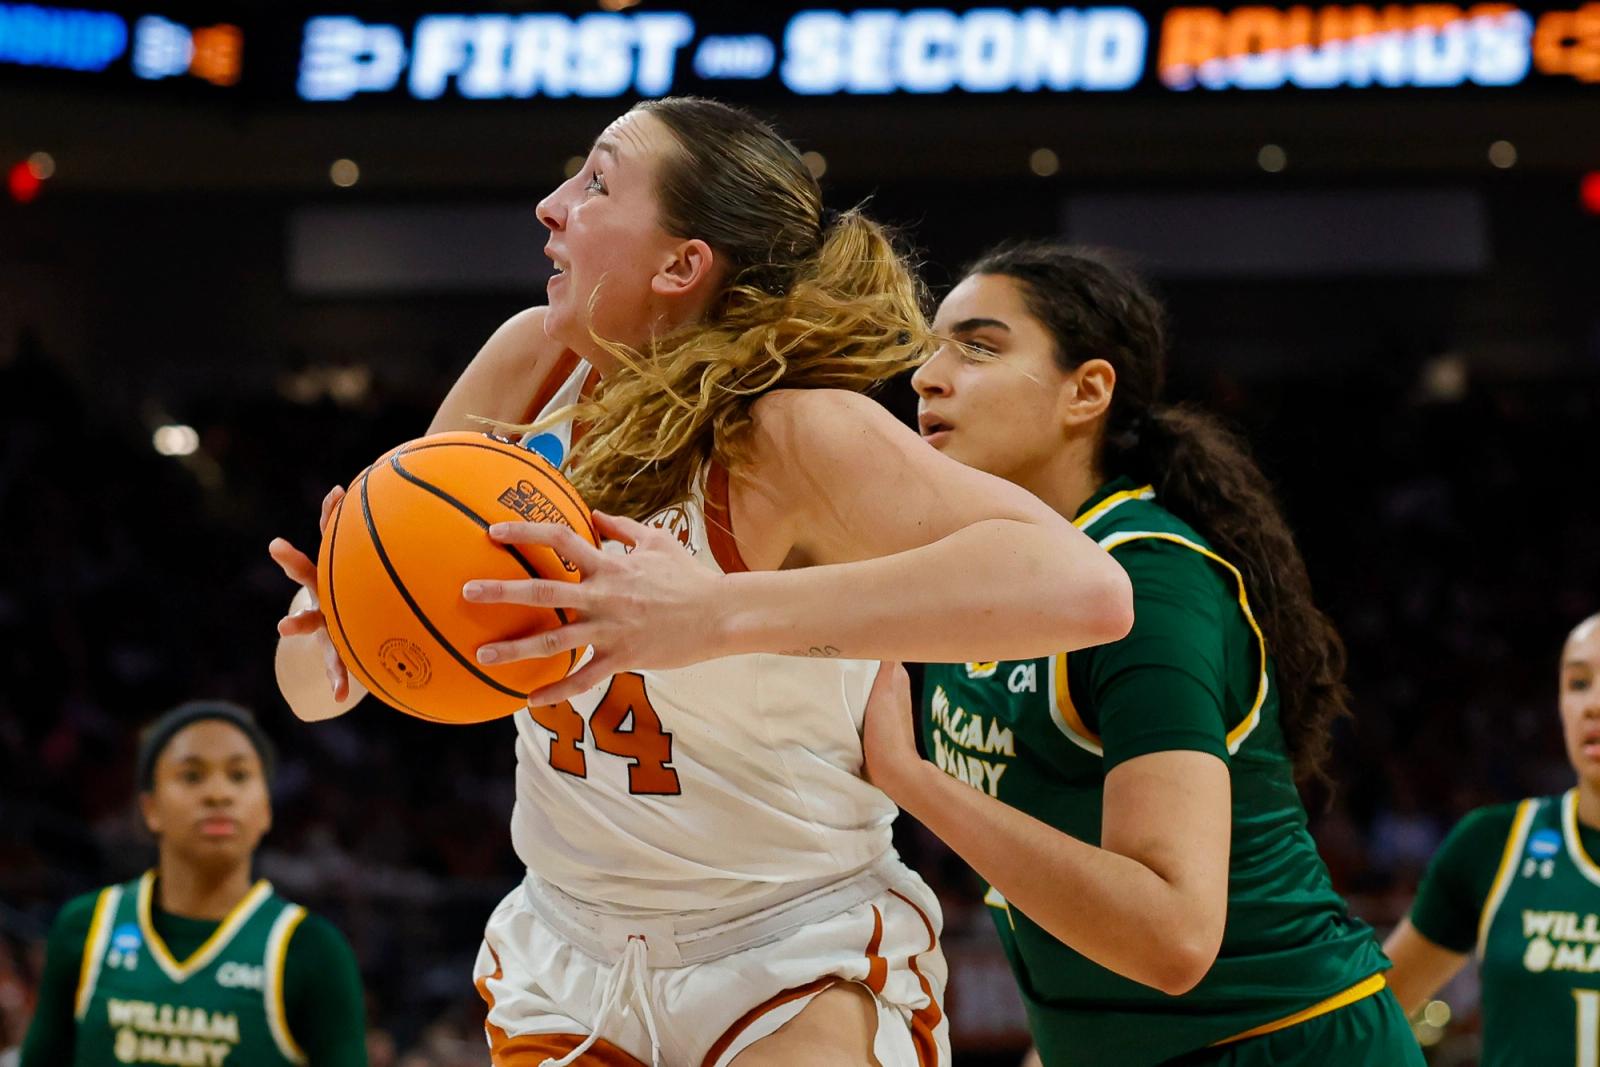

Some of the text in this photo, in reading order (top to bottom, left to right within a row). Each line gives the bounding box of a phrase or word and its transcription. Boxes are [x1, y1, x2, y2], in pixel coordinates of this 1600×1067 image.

[407, 11, 695, 99] FIRST
[779, 6, 1148, 96] SECOND
[1159, 3, 1534, 91] ROUNDS
[527, 671, 682, 796] 44
[107, 997, 241, 1044] WILLIAM
